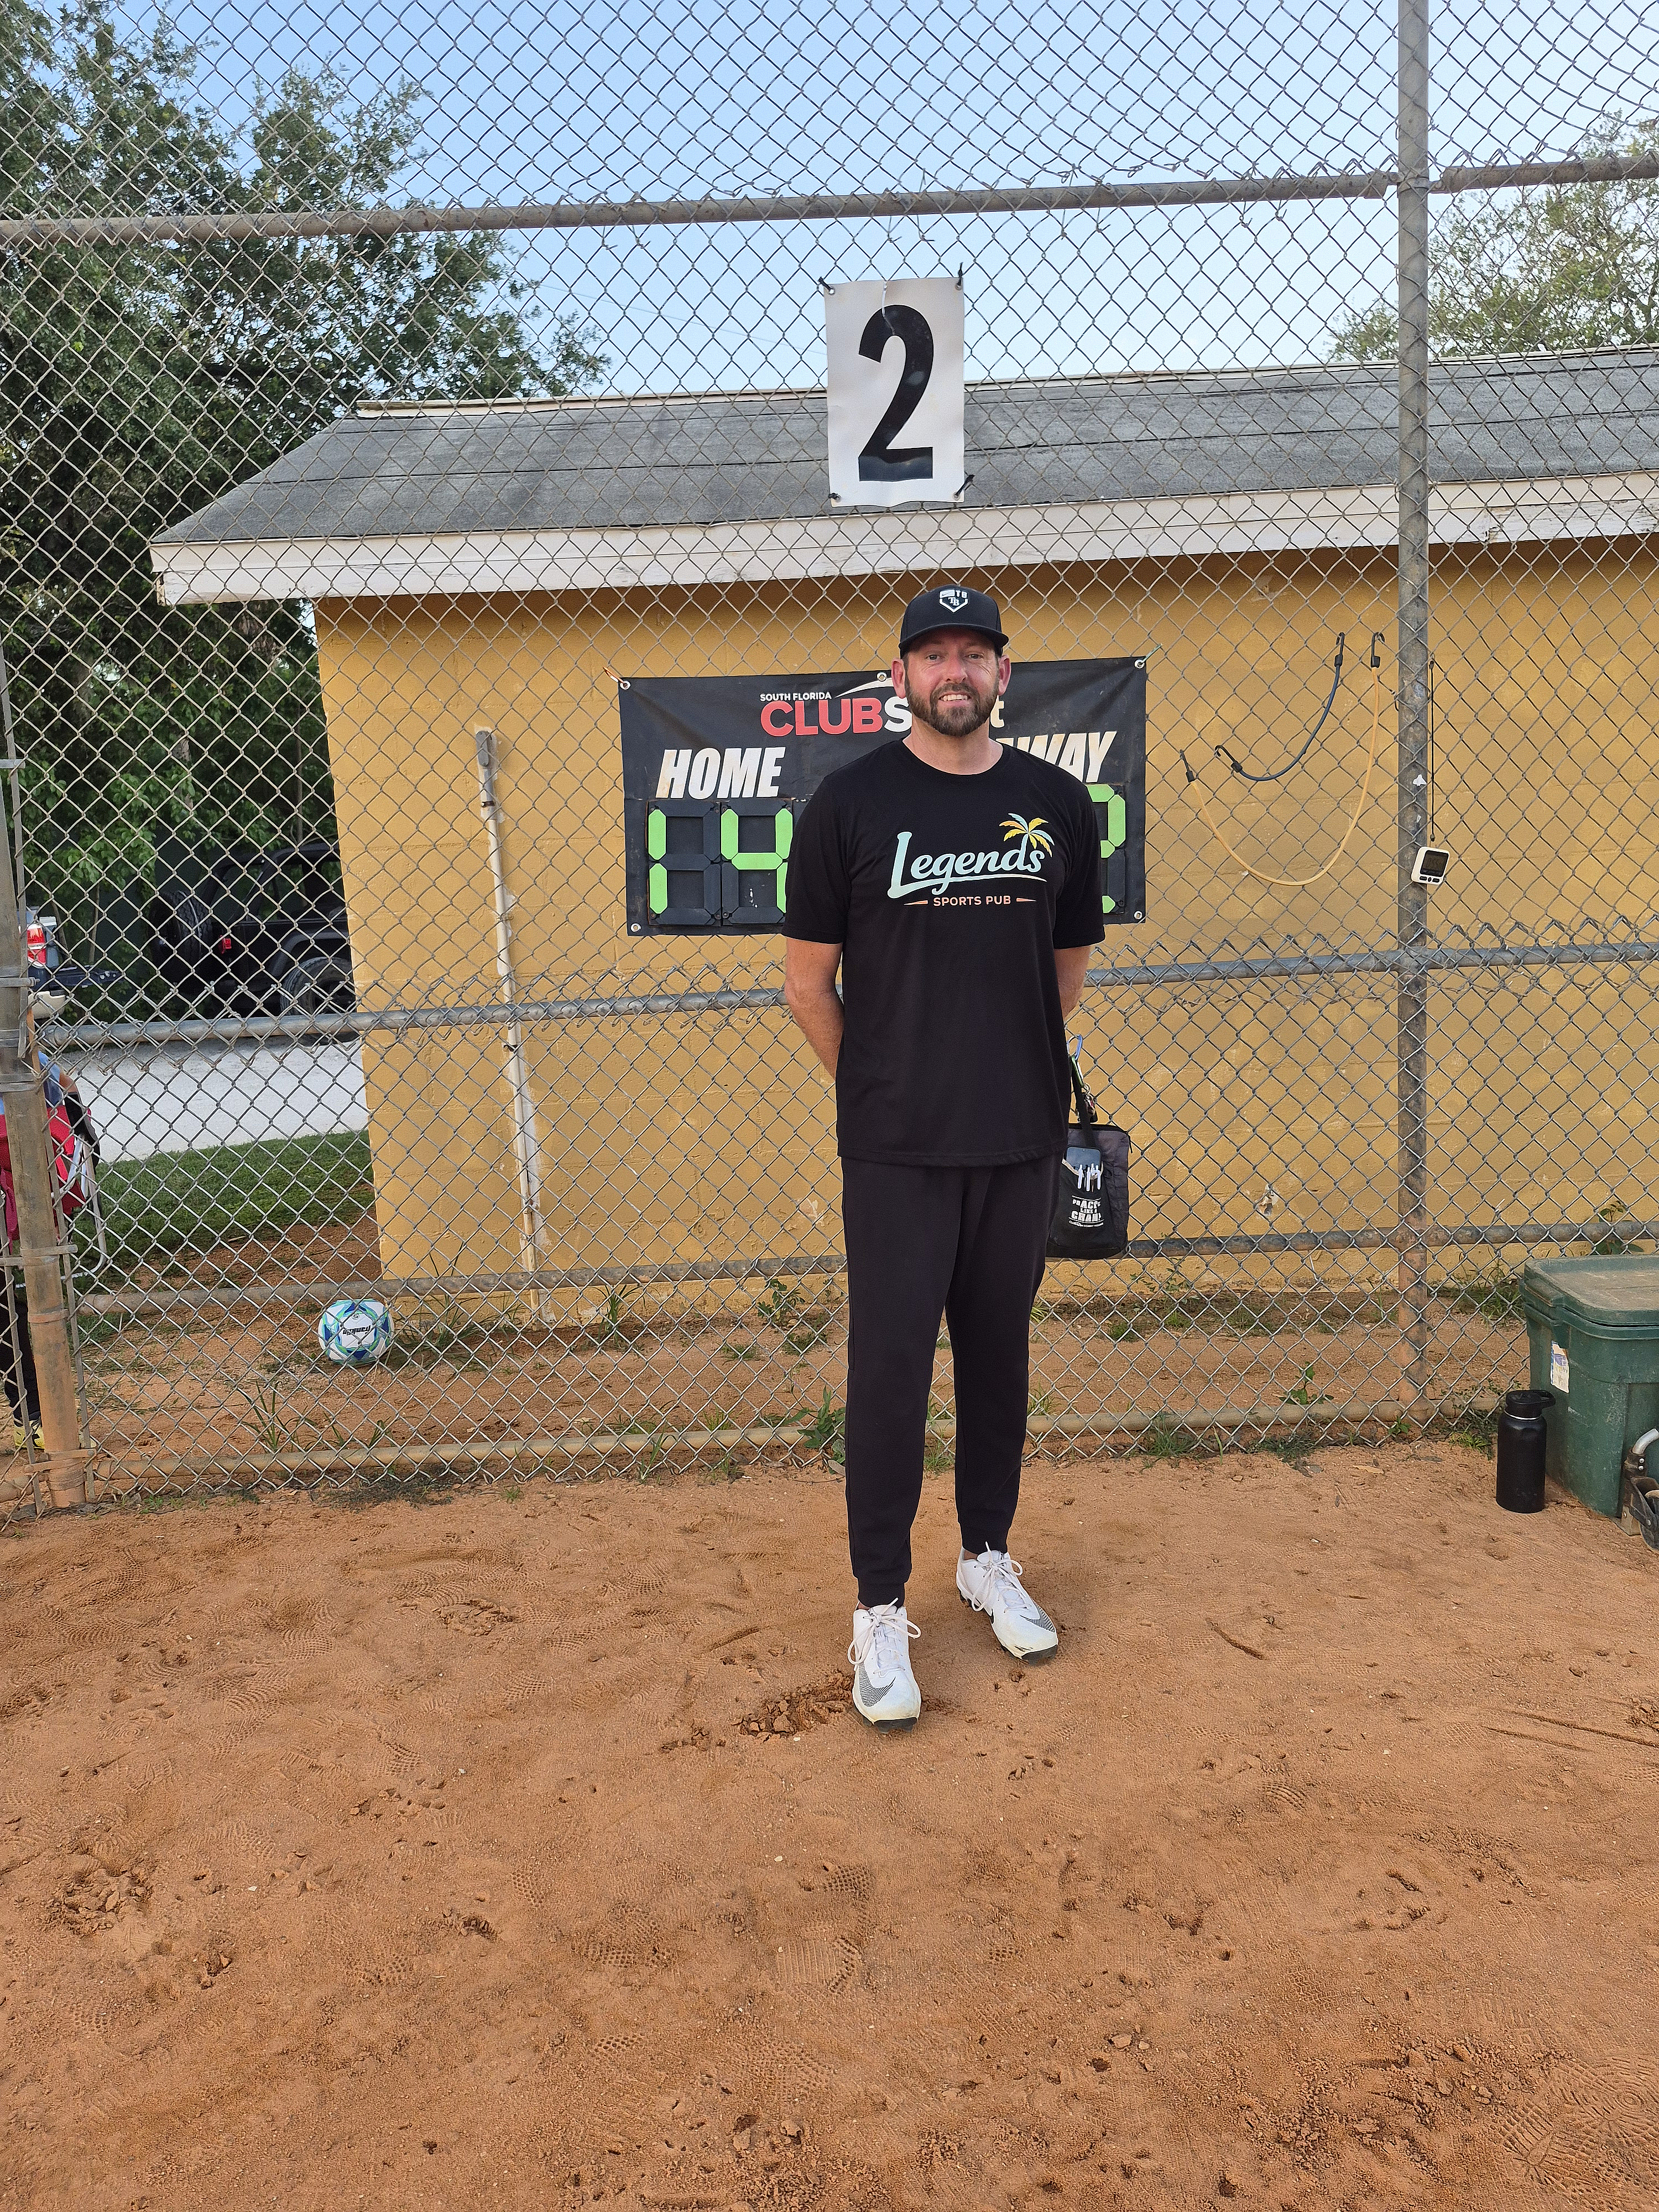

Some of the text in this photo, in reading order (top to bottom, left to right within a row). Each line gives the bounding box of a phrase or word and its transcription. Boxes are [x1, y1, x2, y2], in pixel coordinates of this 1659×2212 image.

[858, 304, 933, 482] 2
[948, 597, 959, 606] TB
[760, 692, 832, 702] SOUTH FLORIDA
[655, 747, 786, 800] HOME
[995, 731, 1118, 783] WAY
[648, 808, 793, 914] 14
[887, 831, 1046, 899] Legends
[933, 895, 1011, 906] SPORTS PUB
